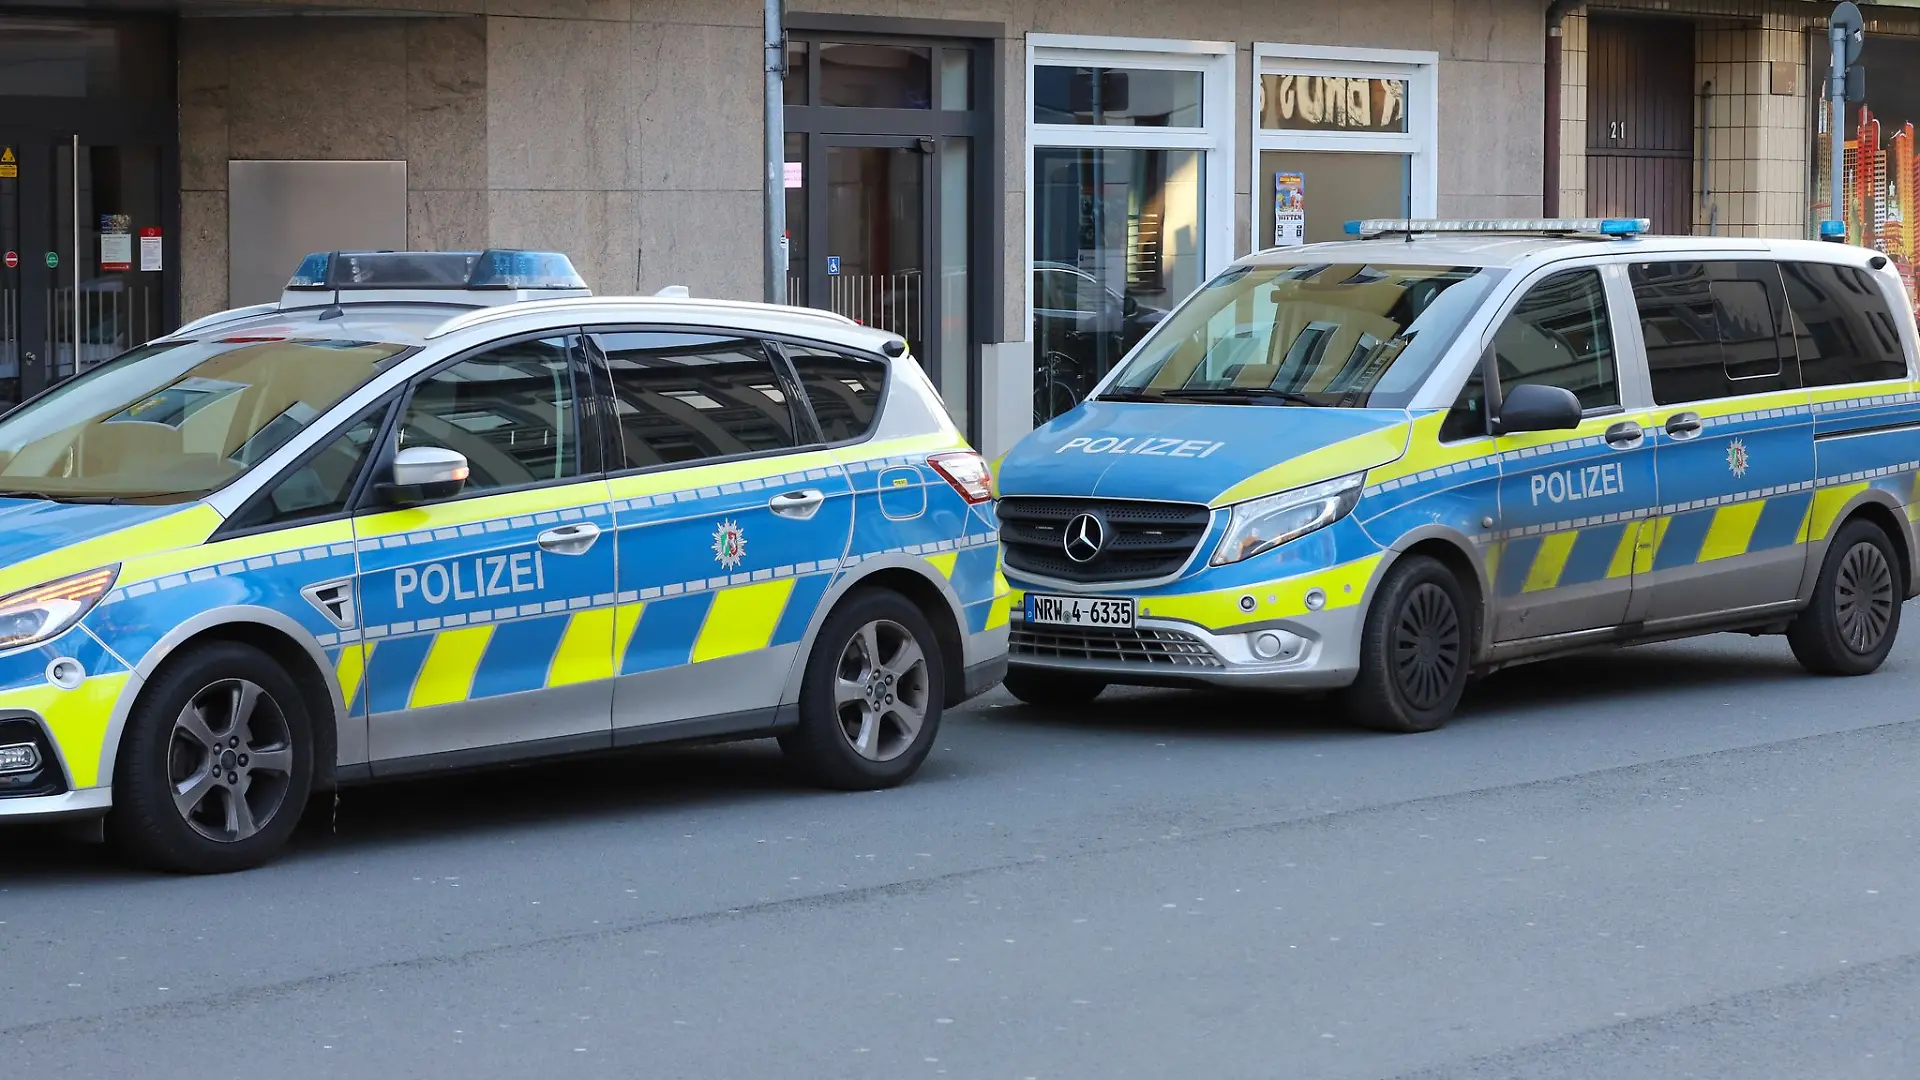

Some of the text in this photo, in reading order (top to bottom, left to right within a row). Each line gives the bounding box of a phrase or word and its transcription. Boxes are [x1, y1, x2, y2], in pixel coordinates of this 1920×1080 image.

[1610, 121, 1624, 139] 21
[1055, 437, 1225, 458] POLIZEI
[1531, 462, 1624, 506] POLIZEI
[394, 550, 544, 609] POLIZEI
[1034, 598, 1062, 622] NRW
[1072, 601, 1131, 624] 4-6335
